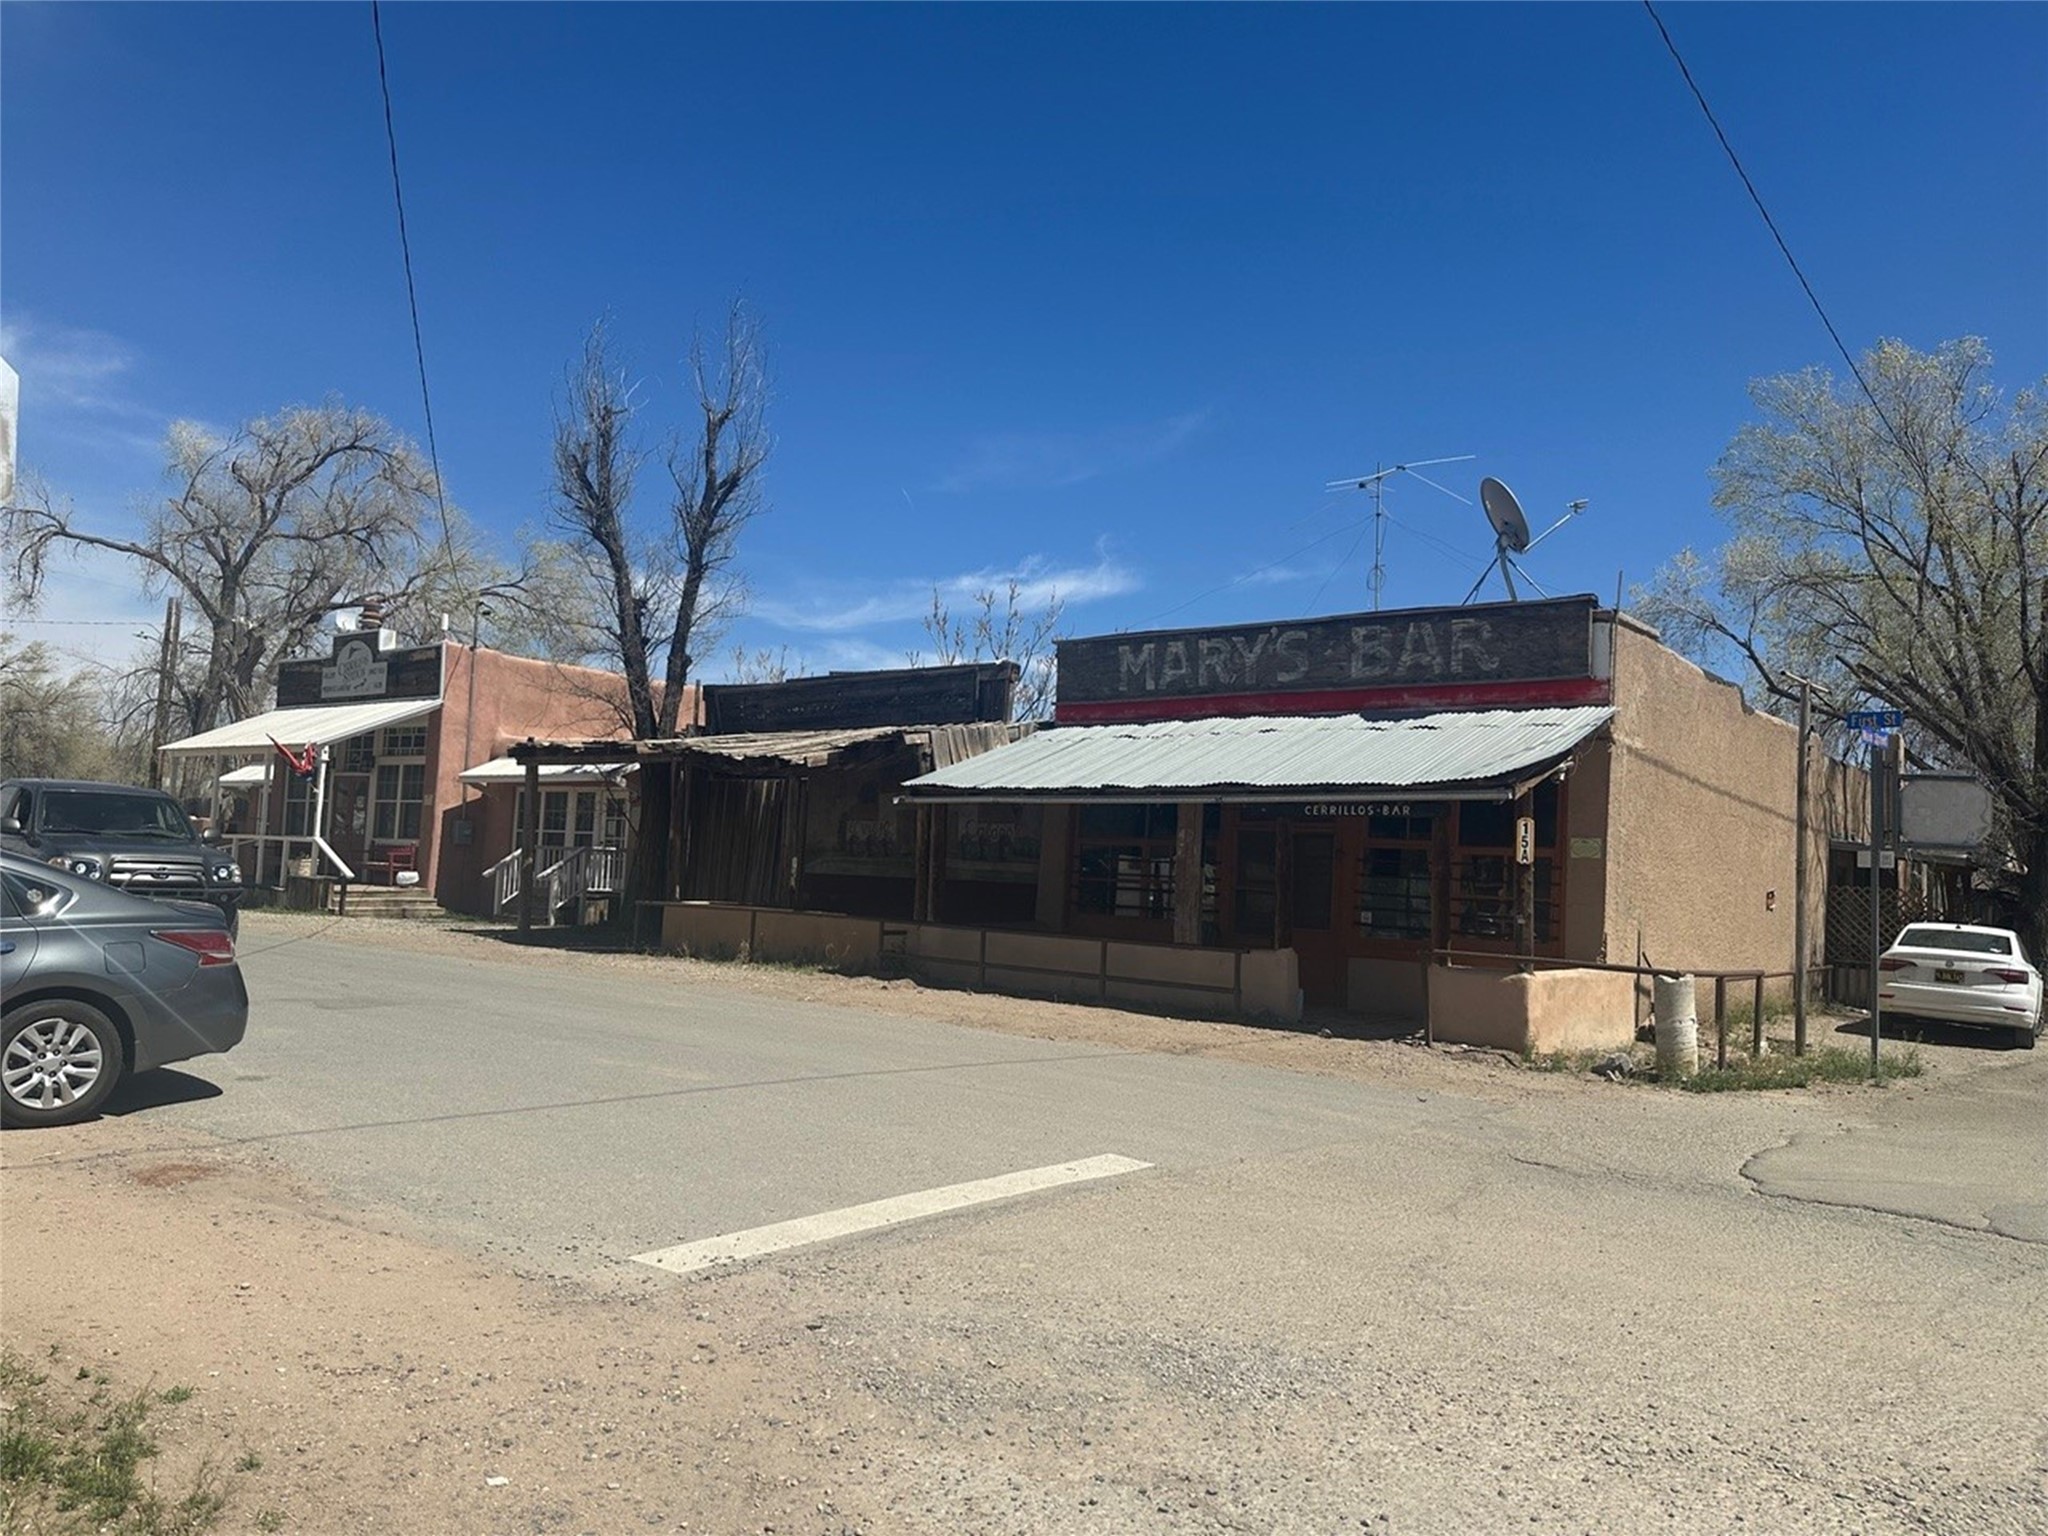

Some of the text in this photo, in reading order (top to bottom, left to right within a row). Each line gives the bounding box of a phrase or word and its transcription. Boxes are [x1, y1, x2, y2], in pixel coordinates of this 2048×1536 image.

[1118, 619, 1501, 690] MARY'S BAR
[1883, 713, 1896, 726] St
